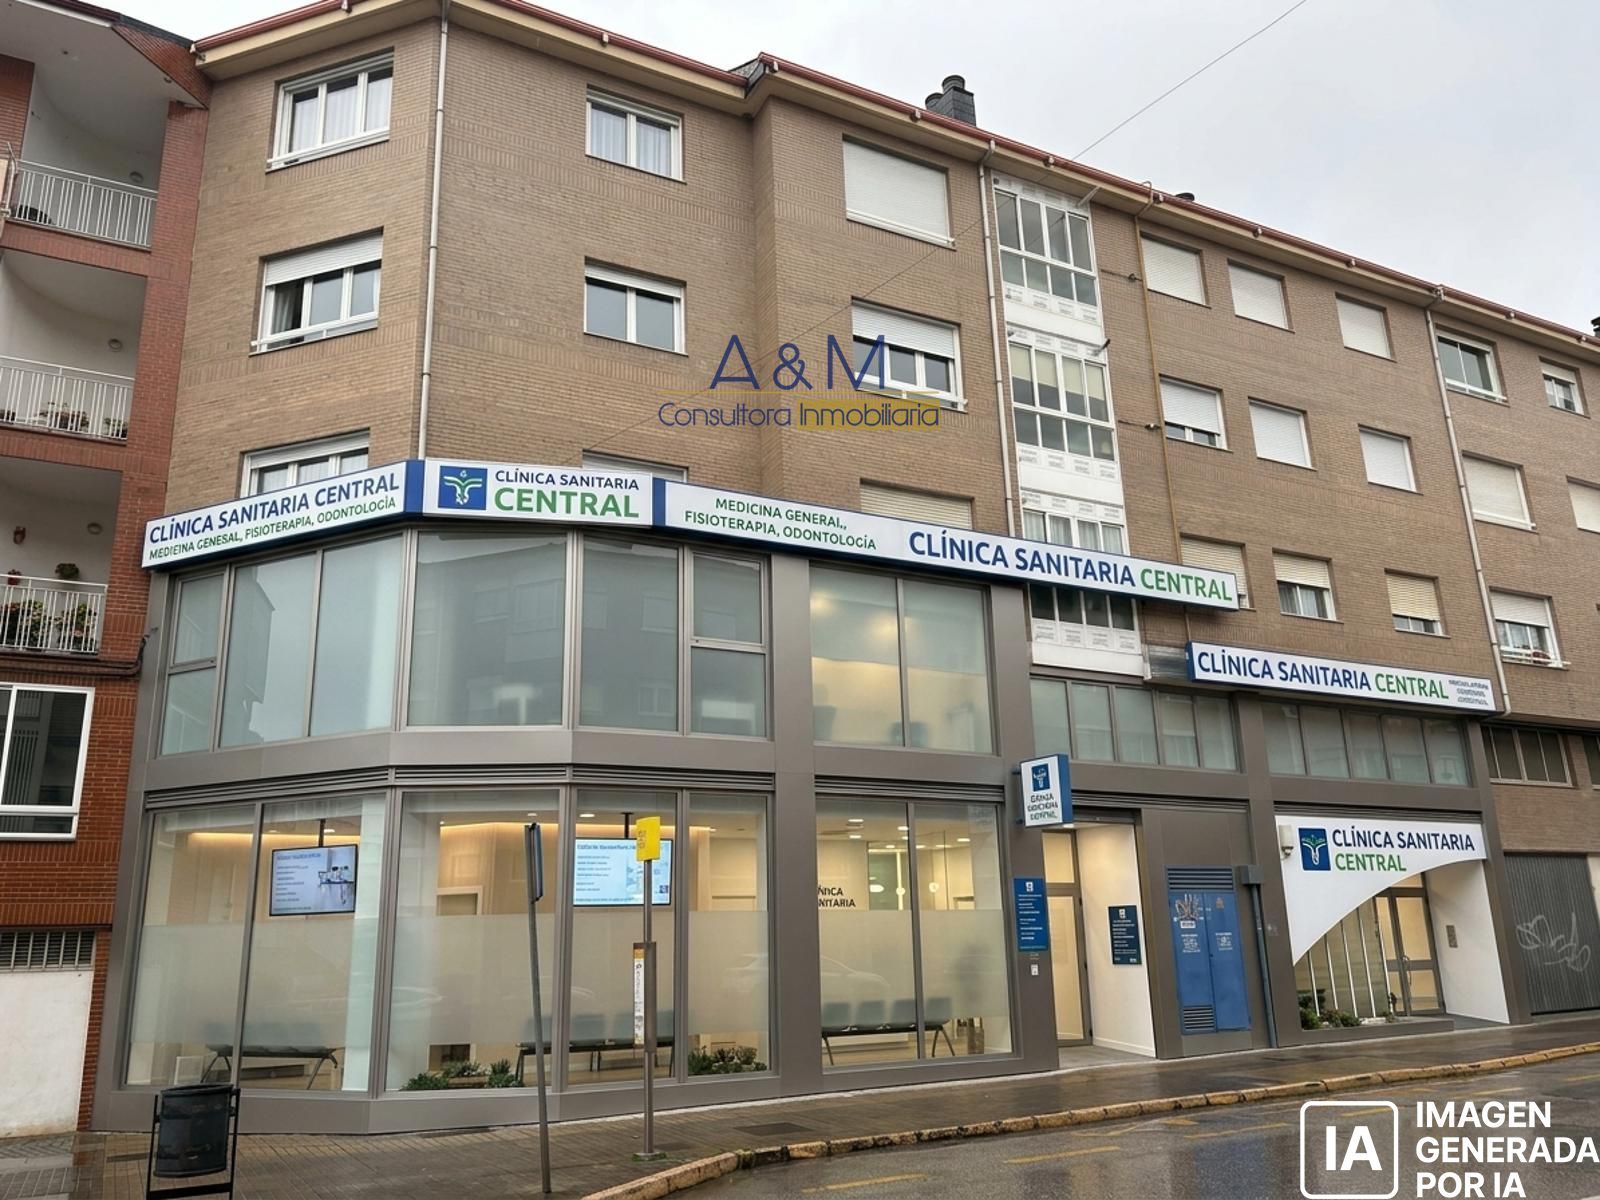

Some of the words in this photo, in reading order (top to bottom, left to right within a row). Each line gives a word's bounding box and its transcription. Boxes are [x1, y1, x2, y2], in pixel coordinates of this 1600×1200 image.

[495, 468, 556, 486] CLÍNICA
[559, 473, 640, 490] SANITARIA
[150, 518, 214, 544] CLÍNICA
[218, 493, 309, 529] SANITARIA
[315, 473, 400, 507] CENTRAL
[494, 487, 640, 518] CENTRAL
[715, 497, 782, 519] MEDICINA
[684, 510, 780, 537] FISIOTERAPIA,
[909, 529, 1009, 568] CLÍNICA
[1015, 548, 1136, 587] SANITARIA
[1140, 568, 1233, 601] CENTRAL
[1197, 649, 1274, 680] CLÍNICA
[1278, 661, 1371, 691] SANITARIA
[1375, 673, 1449, 699] CENTRAL
[1332, 825, 1394, 849] CLÍNICA
[1397, 831, 1475, 851] SANITARIA
[1335, 853, 1407, 872] CENTRAL
